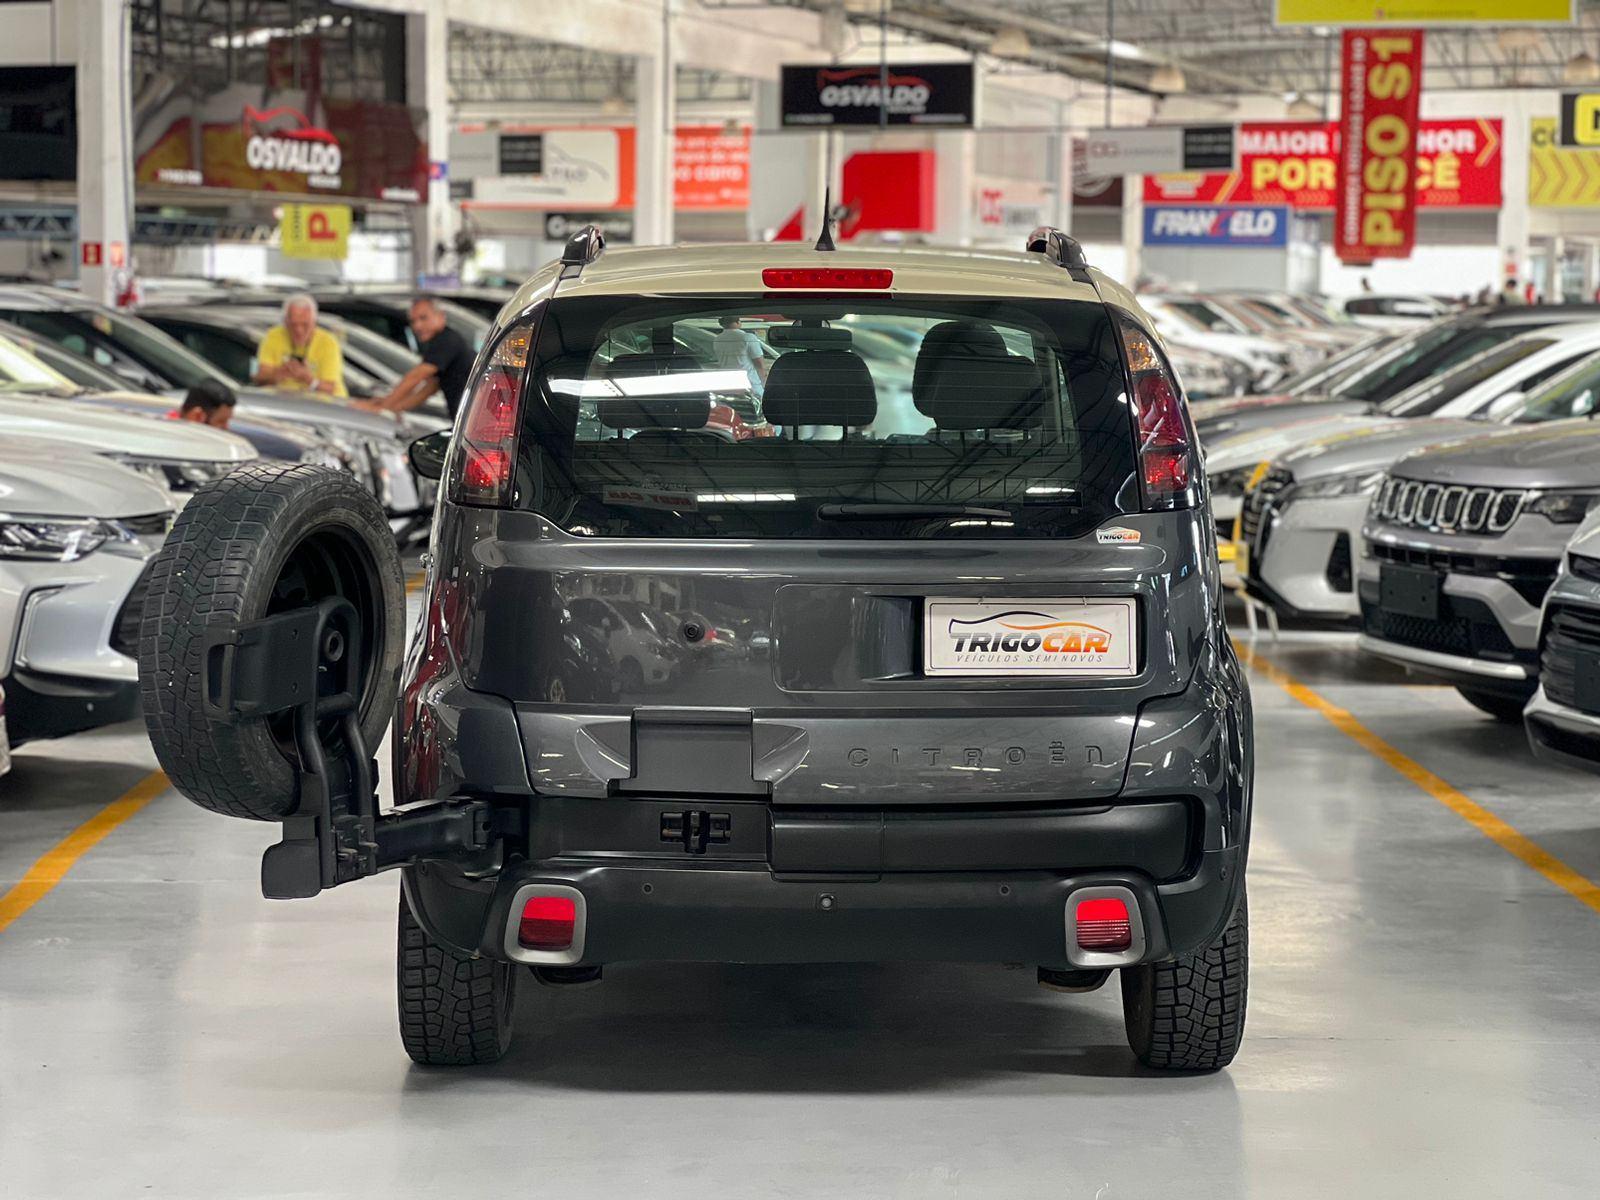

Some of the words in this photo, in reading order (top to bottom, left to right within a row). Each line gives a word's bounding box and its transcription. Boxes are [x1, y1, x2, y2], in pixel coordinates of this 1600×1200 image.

[1367, 37, 1412, 100] S1
[820, 84, 930, 108] OSVALDO
[246, 136, 341, 175] OSVALDO
[1240, 131, 1328, 154] MAIOR
[1252, 158, 1336, 190] POR
[1362, 113, 1410, 247] PISO
[308, 210, 338, 241] P
[949, 632, 1110, 653] TRIGOCAR
[1027, 654, 1104, 664] SEMINOVOS
